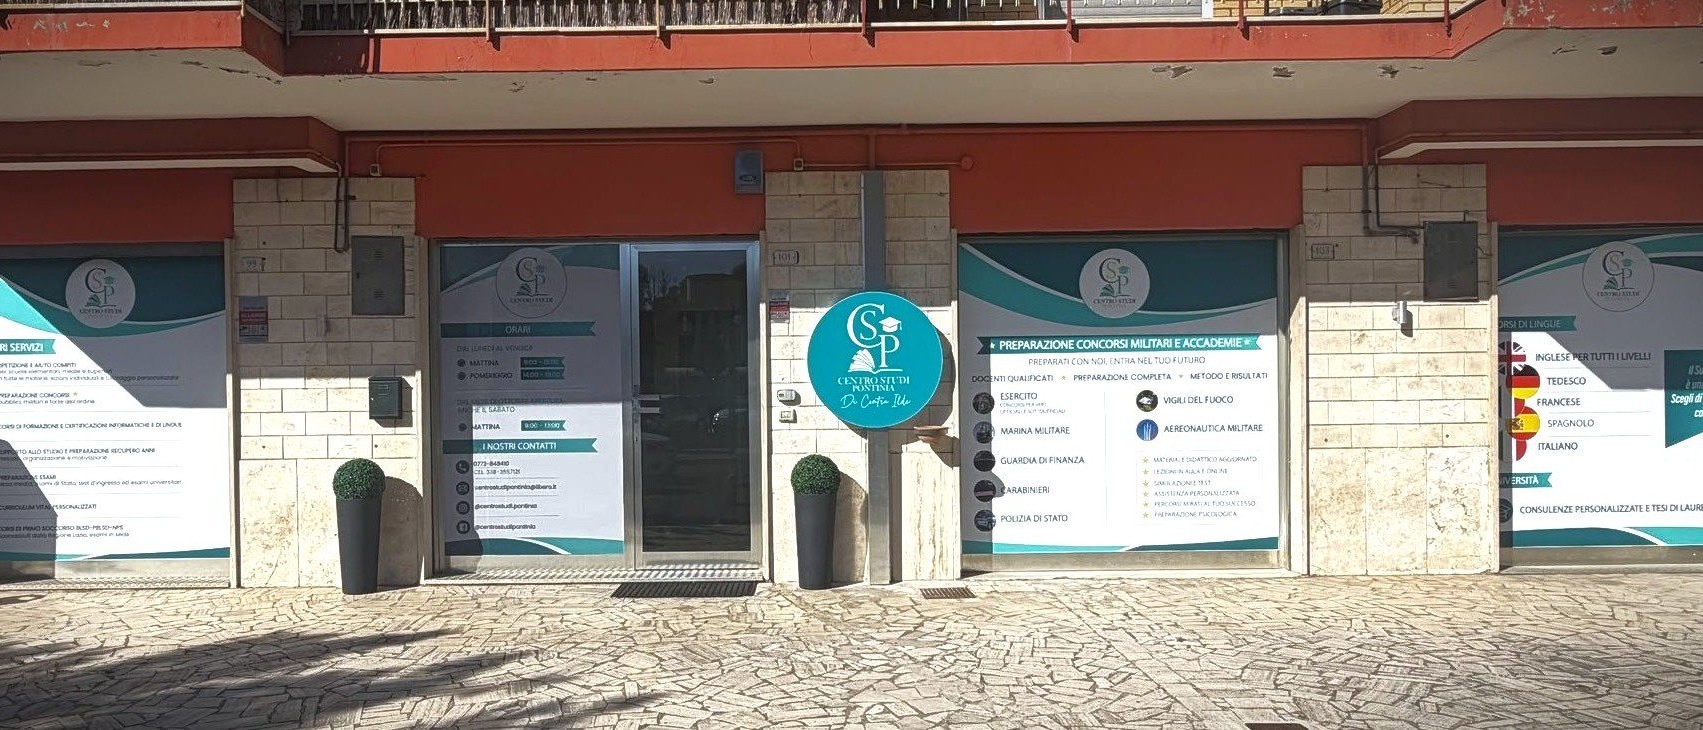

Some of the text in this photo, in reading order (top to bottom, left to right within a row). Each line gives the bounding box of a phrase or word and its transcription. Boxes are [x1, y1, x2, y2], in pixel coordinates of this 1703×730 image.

[1518, 320, 1527, 329] DI
[1529, 319, 1560, 329] LINGUE
[505, 326, 531, 335] ORARI
[10, 342, 44, 351] SERVIZI
[999, 338, 1242, 350] PREPARAZIONE CONCORSI MILITARI E ACCADEMIE
[1028, 358, 1069, 366] PREPARATI
[1071, 358, 1089, 366] CON
[1091, 357, 1108, 366] NOI,
[1137, 357, 1153, 365] NEL
[1536, 352, 1651, 362] INGLESE PER TUTTI I LIVELLI
[469, 359, 499, 367] MATTINA
[972, 375, 1005, 383] DOCENTI
[1231, 372, 1267, 380] RISULTATI
[837, 377, 910, 385] CENTRO STUDI
[1547, 377, 1587, 386] TEDESCO
[852, 384, 895, 392] PONTINIA
[1000, 392, 1038, 400] ESERCITO
[1163, 395, 1234, 404] VIGILI DEL FUOCO
[1671, 393, 1694, 405] Scegli
[1537, 398, 1580, 407] FRANCESE
[1547, 418, 1595, 428] SPAGNOLO
[1000, 427, 1032, 435] MARINA
[1227, 424, 1263, 432] MILITARE
[517, 442, 556, 450] CONTATTI
[1538, 442, 1578, 451] ITALIANO
[1039, 456, 1047, 464] DI
[1049, 456, 1085, 464] FINANZA
[1000, 486, 1050, 495] CARABINIERI
[1520, 506, 1573, 514] CONSULENZE
[1575, 505, 1643, 513] PERSONALIZZATE
[1646, 504, 1650, 512] E
[1652, 504, 1668, 512] TESI
[1670, 503, 1678, 512] DI
[1034, 515, 1042, 523] DI
